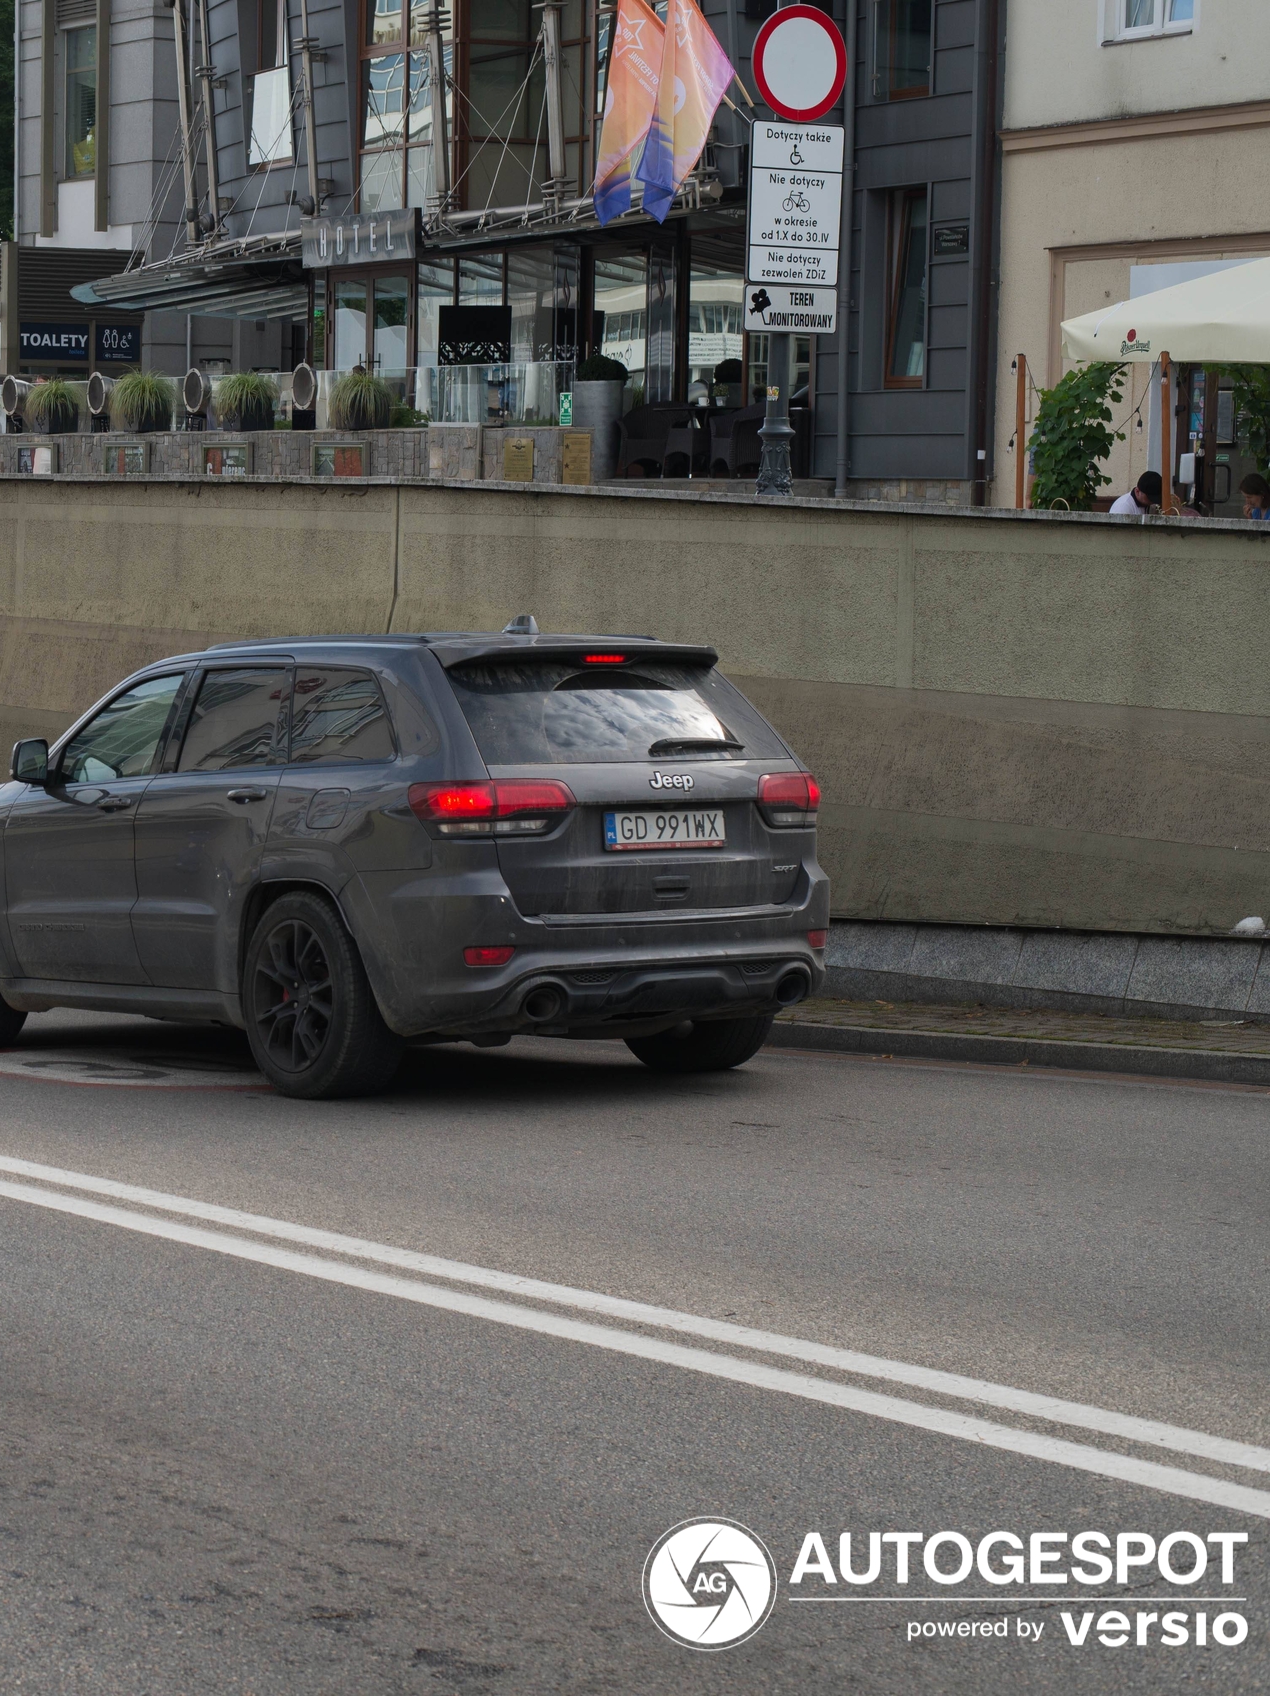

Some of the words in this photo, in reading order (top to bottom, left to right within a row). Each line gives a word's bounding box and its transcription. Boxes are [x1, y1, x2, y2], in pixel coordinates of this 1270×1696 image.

[767, 128, 803, 143] Dotyczy
[806, 132, 831, 142] także
[769, 173, 785, 184] Nie
[790, 175, 825, 189] dotyczy
[784, 216, 817, 227] okresie
[320, 221, 394, 257] HOTEL
[761, 230, 773, 239] od
[776, 230, 788, 240] 1.X
[791, 232, 803, 241] do
[806, 232, 829, 242] 30.IV
[768, 252, 784, 262] Nie
[787, 253, 821, 267] dotyczy
[761, 268, 803, 278] zezwoleń
[806, 269, 826, 279] ZDiZ
[790, 292, 814, 306] TEREN
[769, 312, 833, 328] MONITOROWANY
[21, 332, 88, 348] TOALETY
[650, 771, 694, 792] Jeep
[621, 816, 648, 840] GD
[656, 813, 719, 840] 991WX
[607, 831, 616, 839] PL
[771, 864, 798, 873] SRT
